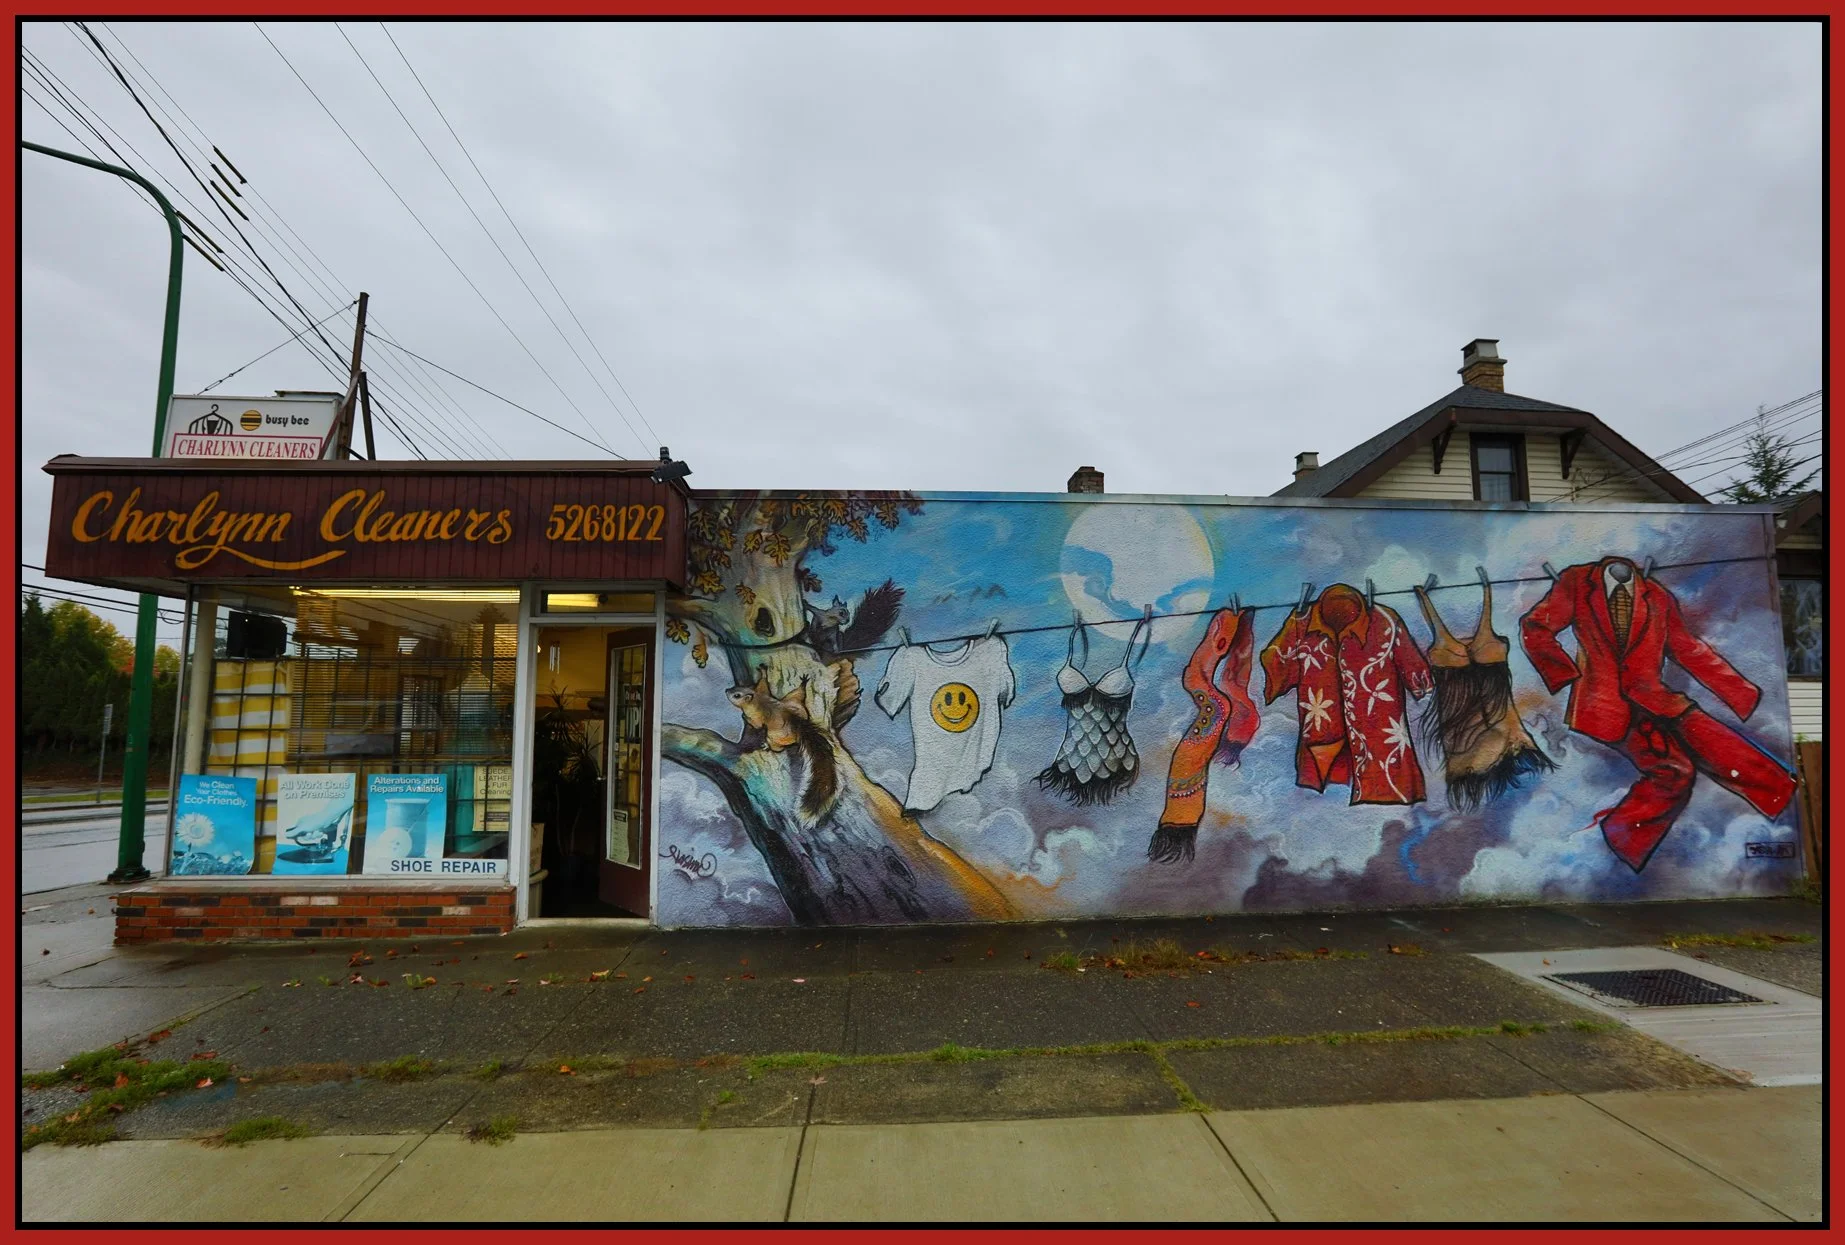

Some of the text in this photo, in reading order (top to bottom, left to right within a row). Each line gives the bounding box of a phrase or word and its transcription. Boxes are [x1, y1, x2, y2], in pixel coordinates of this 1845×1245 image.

[266, 414, 310, 428] busy bee
[178, 439, 316, 460] CHARLYNN CLEANERS
[71, 487, 347, 570] Charlynn
[320, 489, 513, 545] Cleaners
[211, 780, 235, 790] Clean
[280, 780, 351, 790] All Work Done
[374, 776, 440, 785] Alterations and
[195, 787, 211, 795] Your
[370, 784, 444, 794] Repairs Available
[285, 790, 346, 800] on Premises
[184, 794, 249, 808] Eco-Friendly.
[391, 860, 497, 873] SHOE REPAIR
